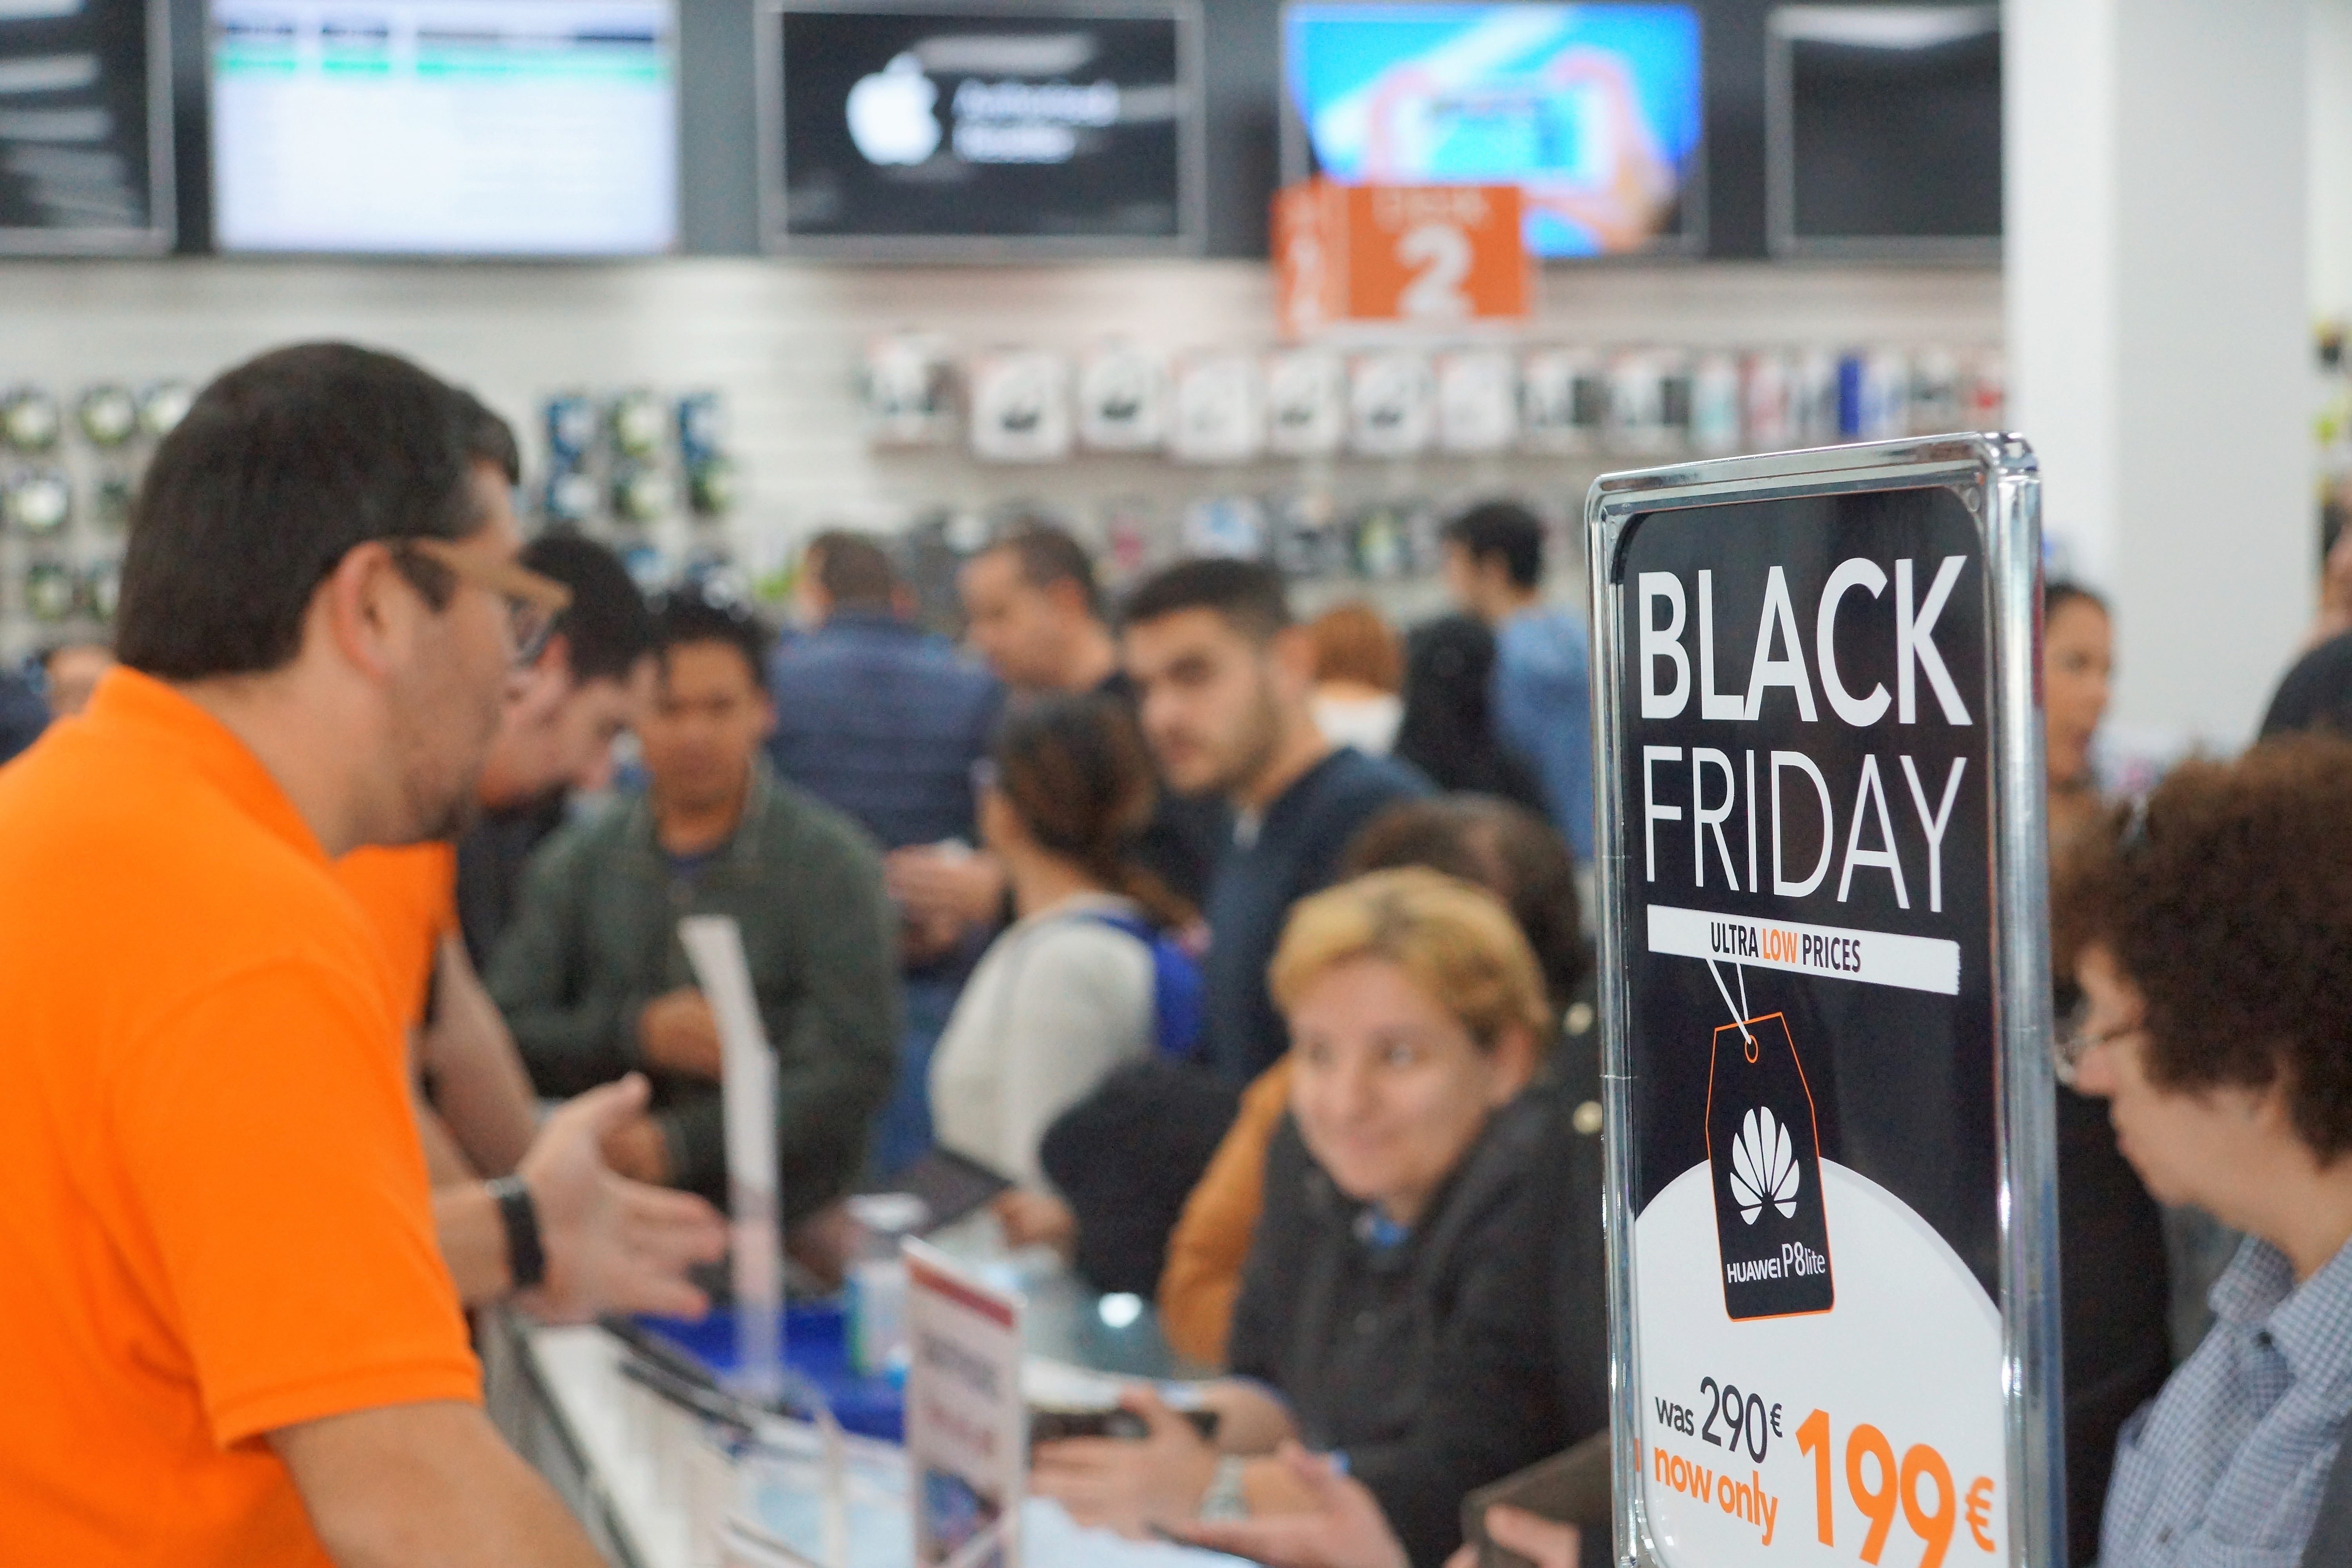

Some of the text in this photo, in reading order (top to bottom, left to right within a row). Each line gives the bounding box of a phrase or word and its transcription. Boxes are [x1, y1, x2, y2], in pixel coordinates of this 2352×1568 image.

[1394, 223, 1475, 319] 2
[1639, 555, 1973, 727] BLACK
[1642, 745, 1967, 913] FRIDAY
[1711, 921, 1862, 973] ULTRA LOW PRICES
[1726, 1241, 1826, 1283] HUAWEI P8lite
[1655, 1376, 1783, 1464] was 290€
[1654, 1446, 1779, 1546] now only
[1795, 1408, 1996, 1568] 199€
